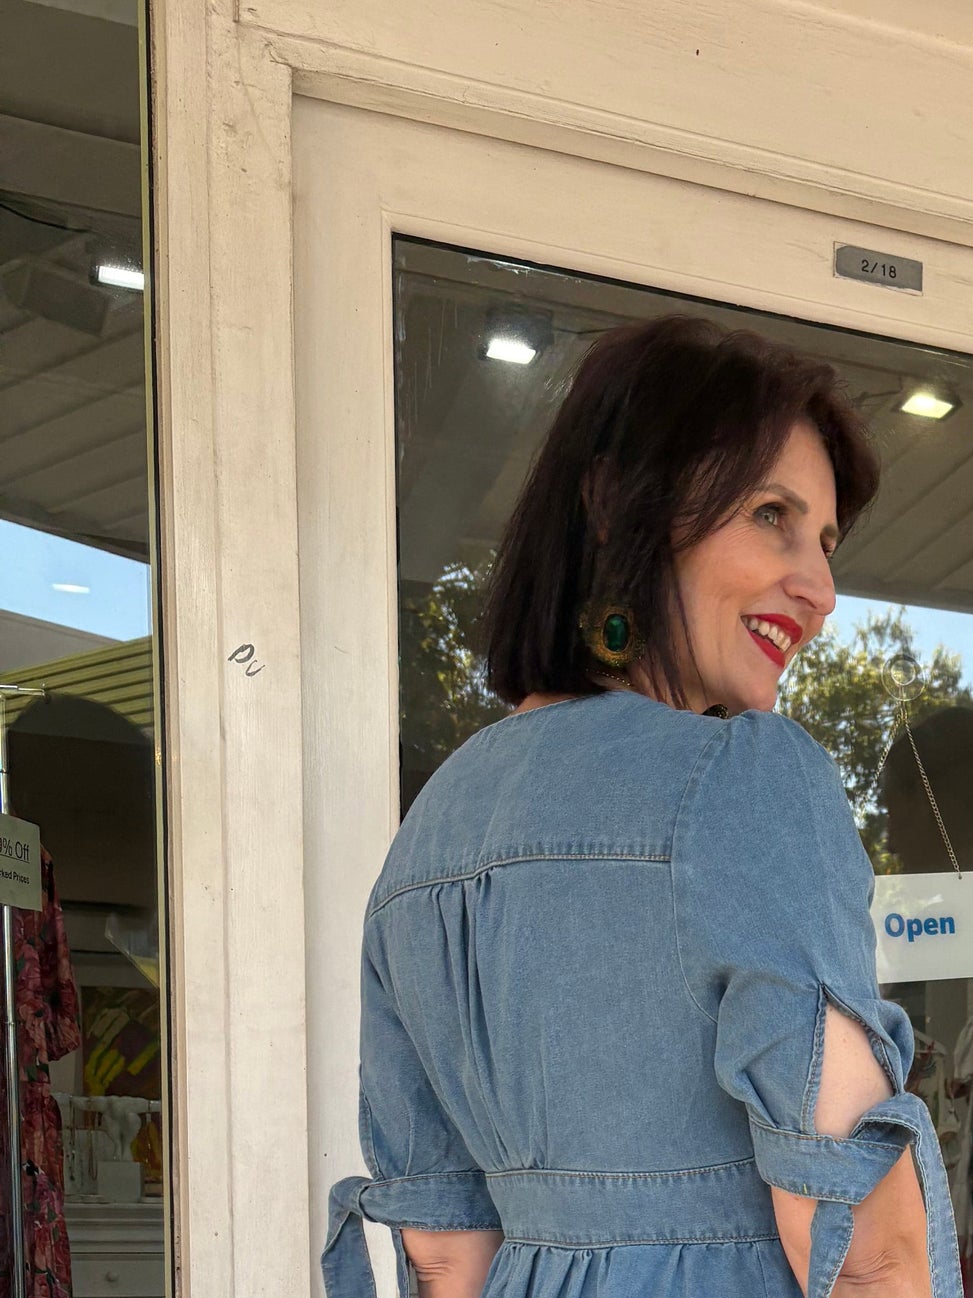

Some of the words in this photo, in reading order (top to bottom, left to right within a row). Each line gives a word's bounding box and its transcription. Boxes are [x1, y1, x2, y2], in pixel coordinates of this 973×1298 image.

[861, 259, 896, 278] 2/18
[15, 841, 30, 862] Off
[885, 912, 955, 943] Open
